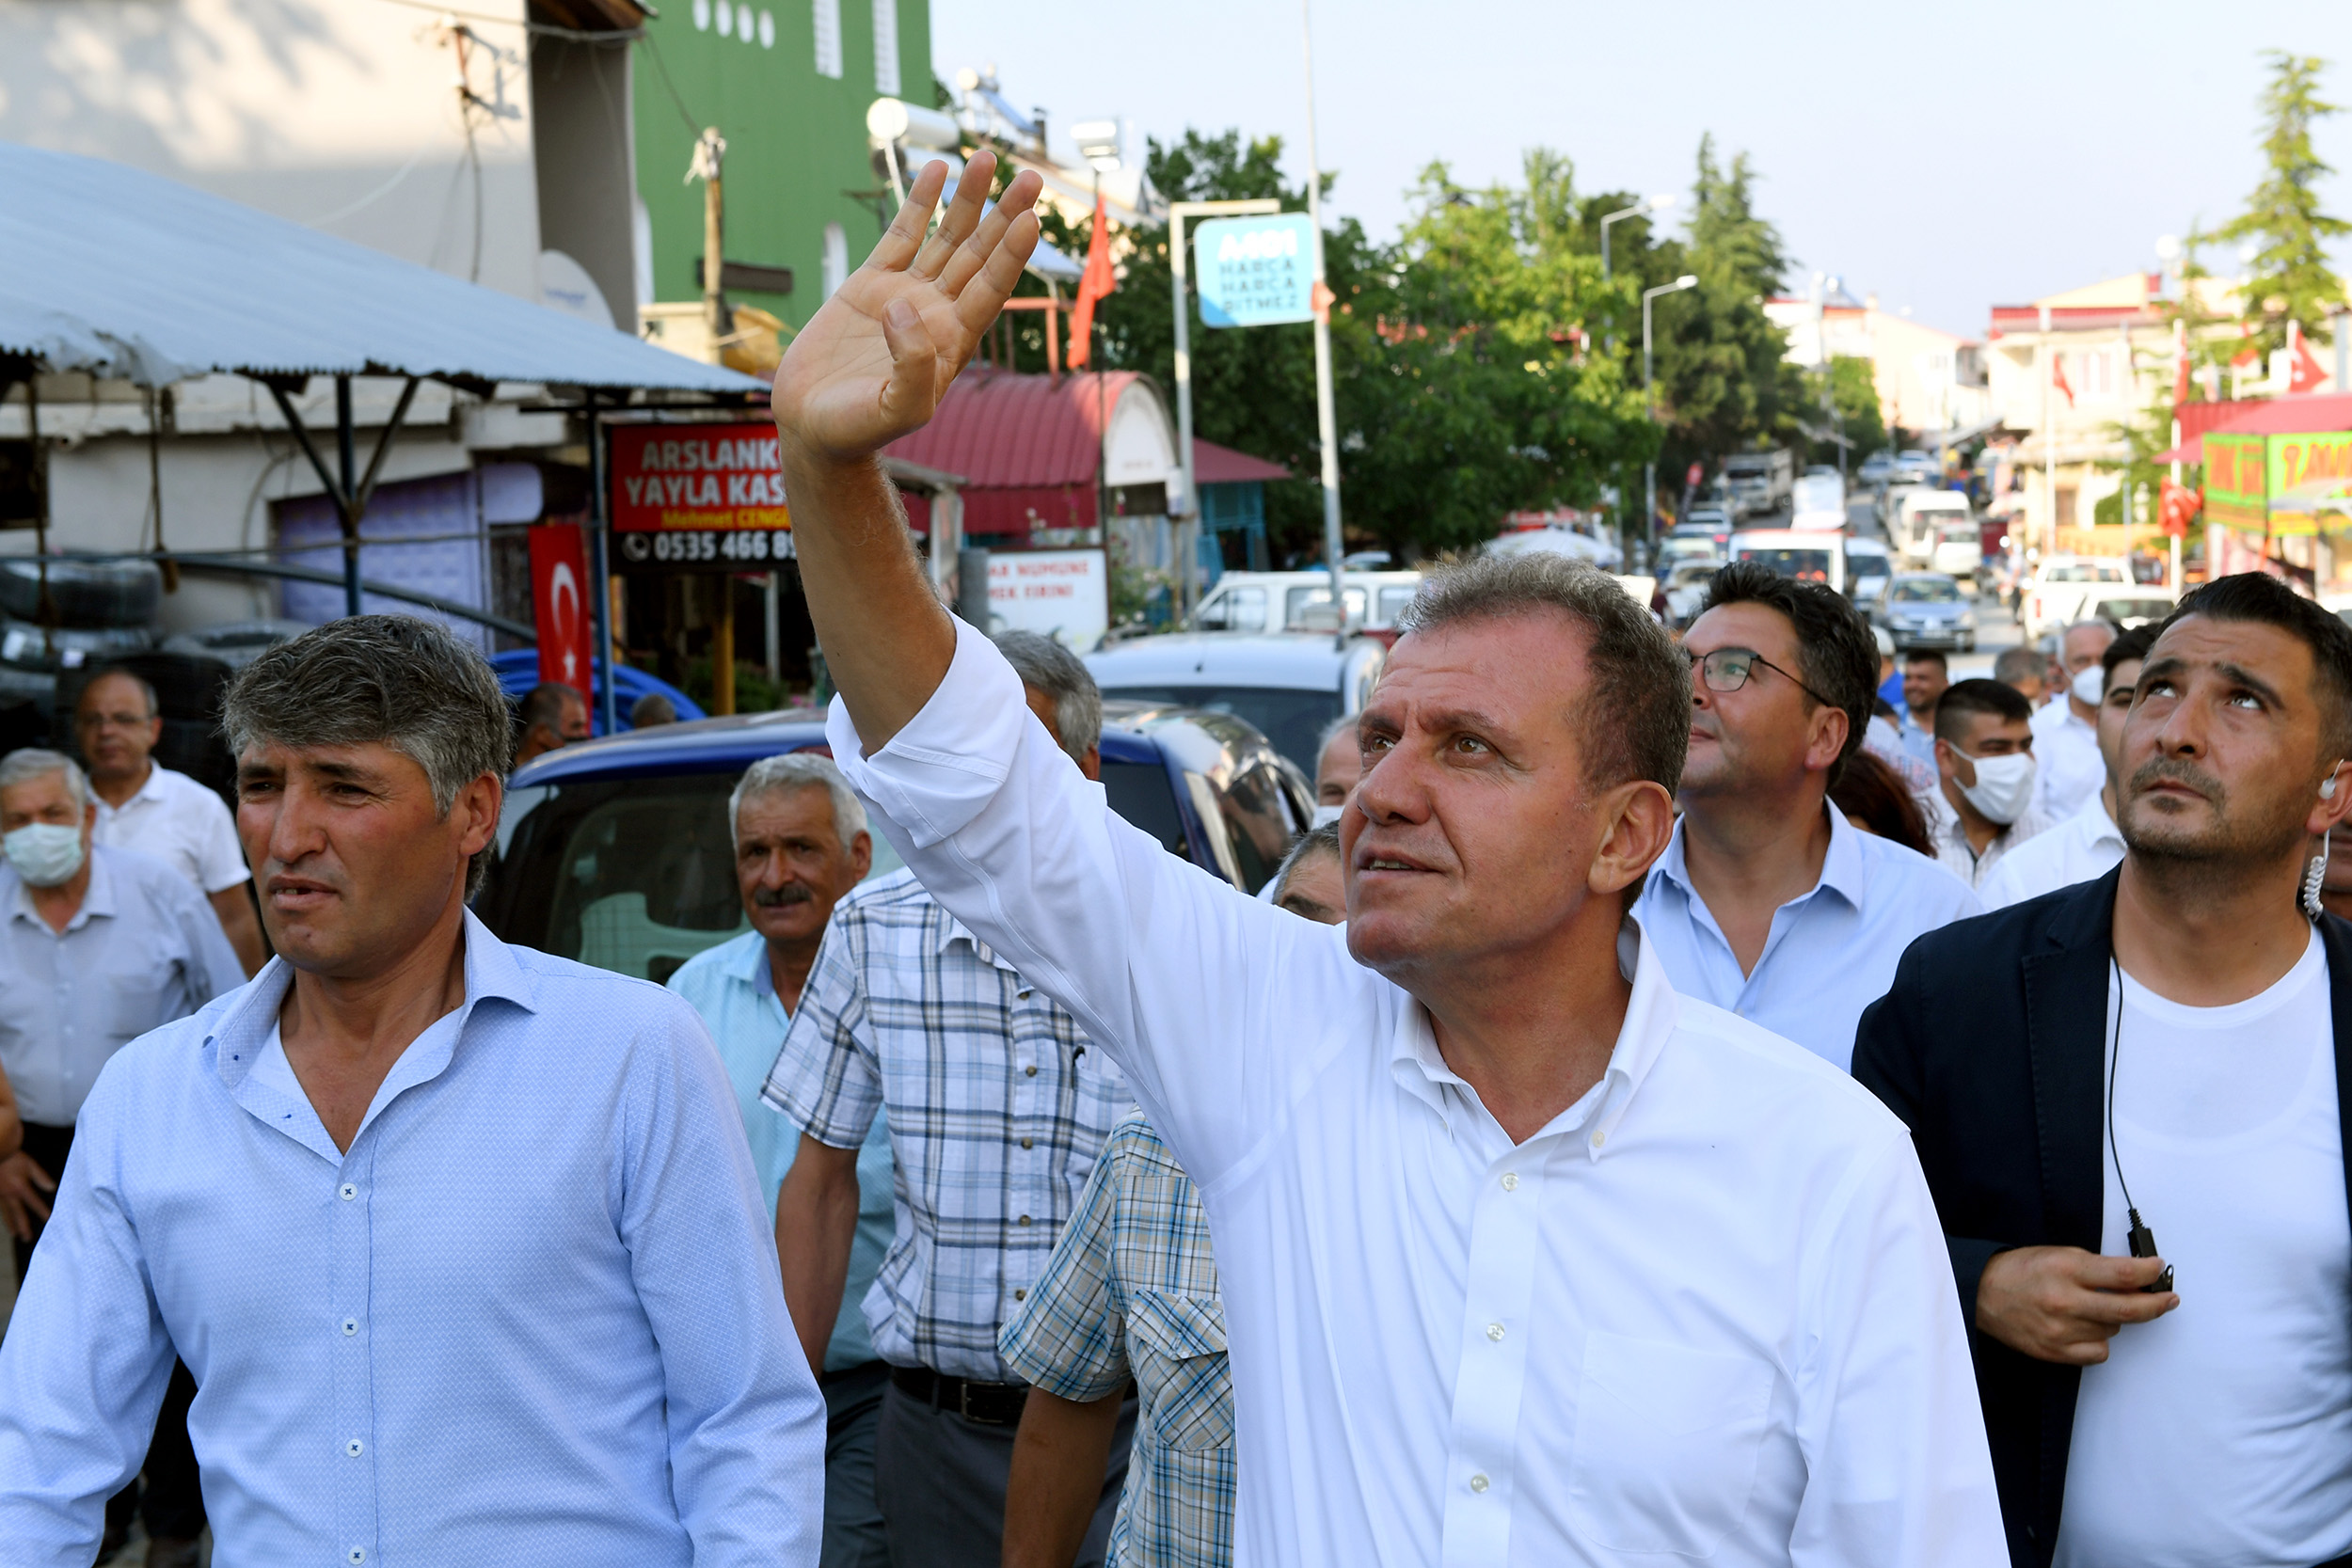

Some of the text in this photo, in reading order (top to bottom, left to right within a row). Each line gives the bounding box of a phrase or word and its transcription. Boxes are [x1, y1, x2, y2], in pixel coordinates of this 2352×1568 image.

[1217, 229, 1297, 261] A101
[1220, 259, 1295, 275] HARCA
[1222, 277, 1295, 293] HARCA
[625, 473, 786, 508] YAYLA KAS
[661, 508, 734, 530] Mehmet
[654, 531, 716, 562] 0535
[721, 531, 769, 561] 466
